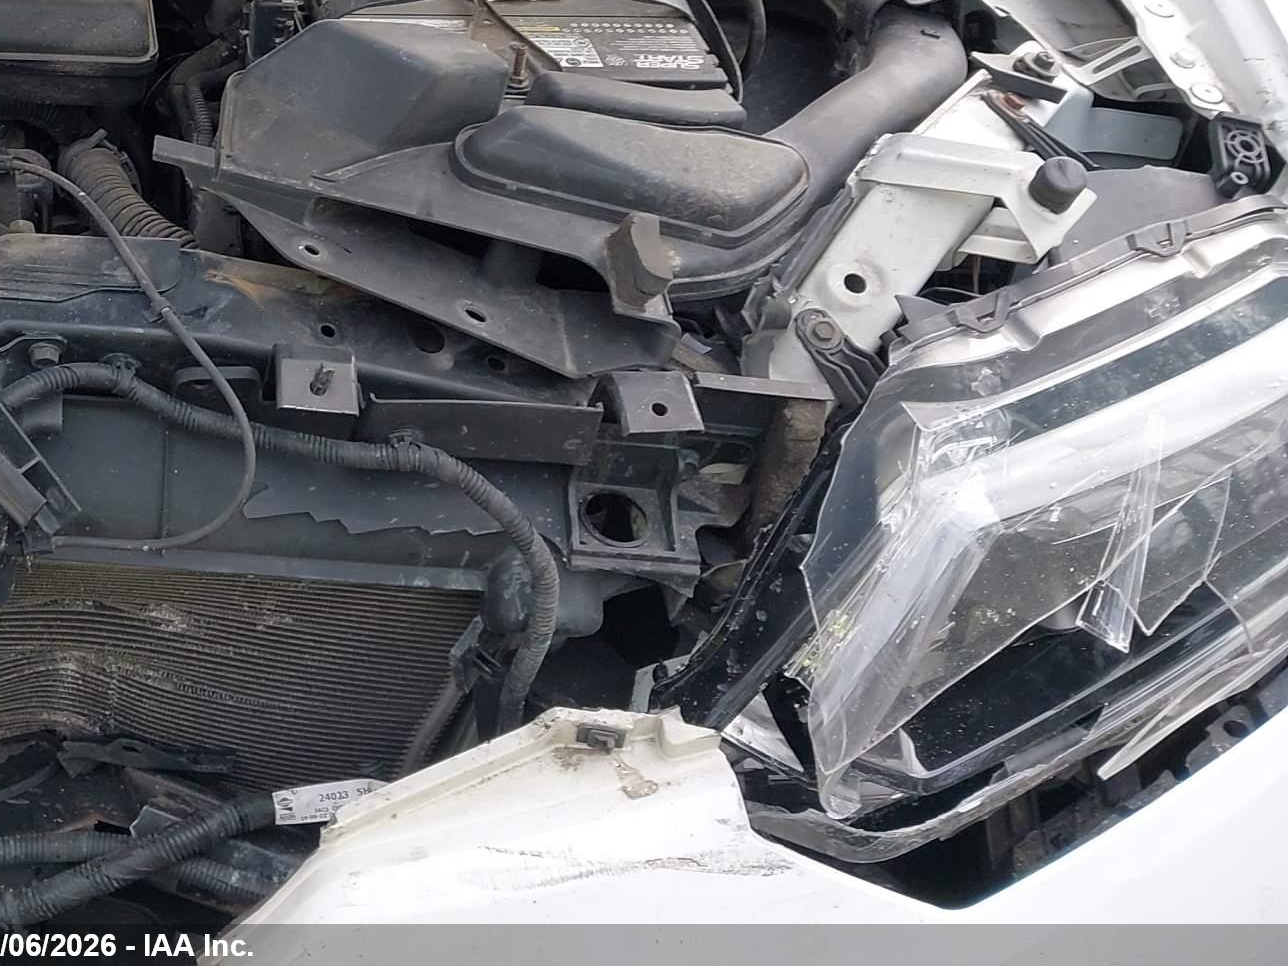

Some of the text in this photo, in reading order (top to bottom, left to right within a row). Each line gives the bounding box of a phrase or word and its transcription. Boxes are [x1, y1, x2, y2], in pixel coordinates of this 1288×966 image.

[633, 54, 705, 64] START
[635, 61, 700, 70] SUPER
[319, 791, 349, 802] 24023
